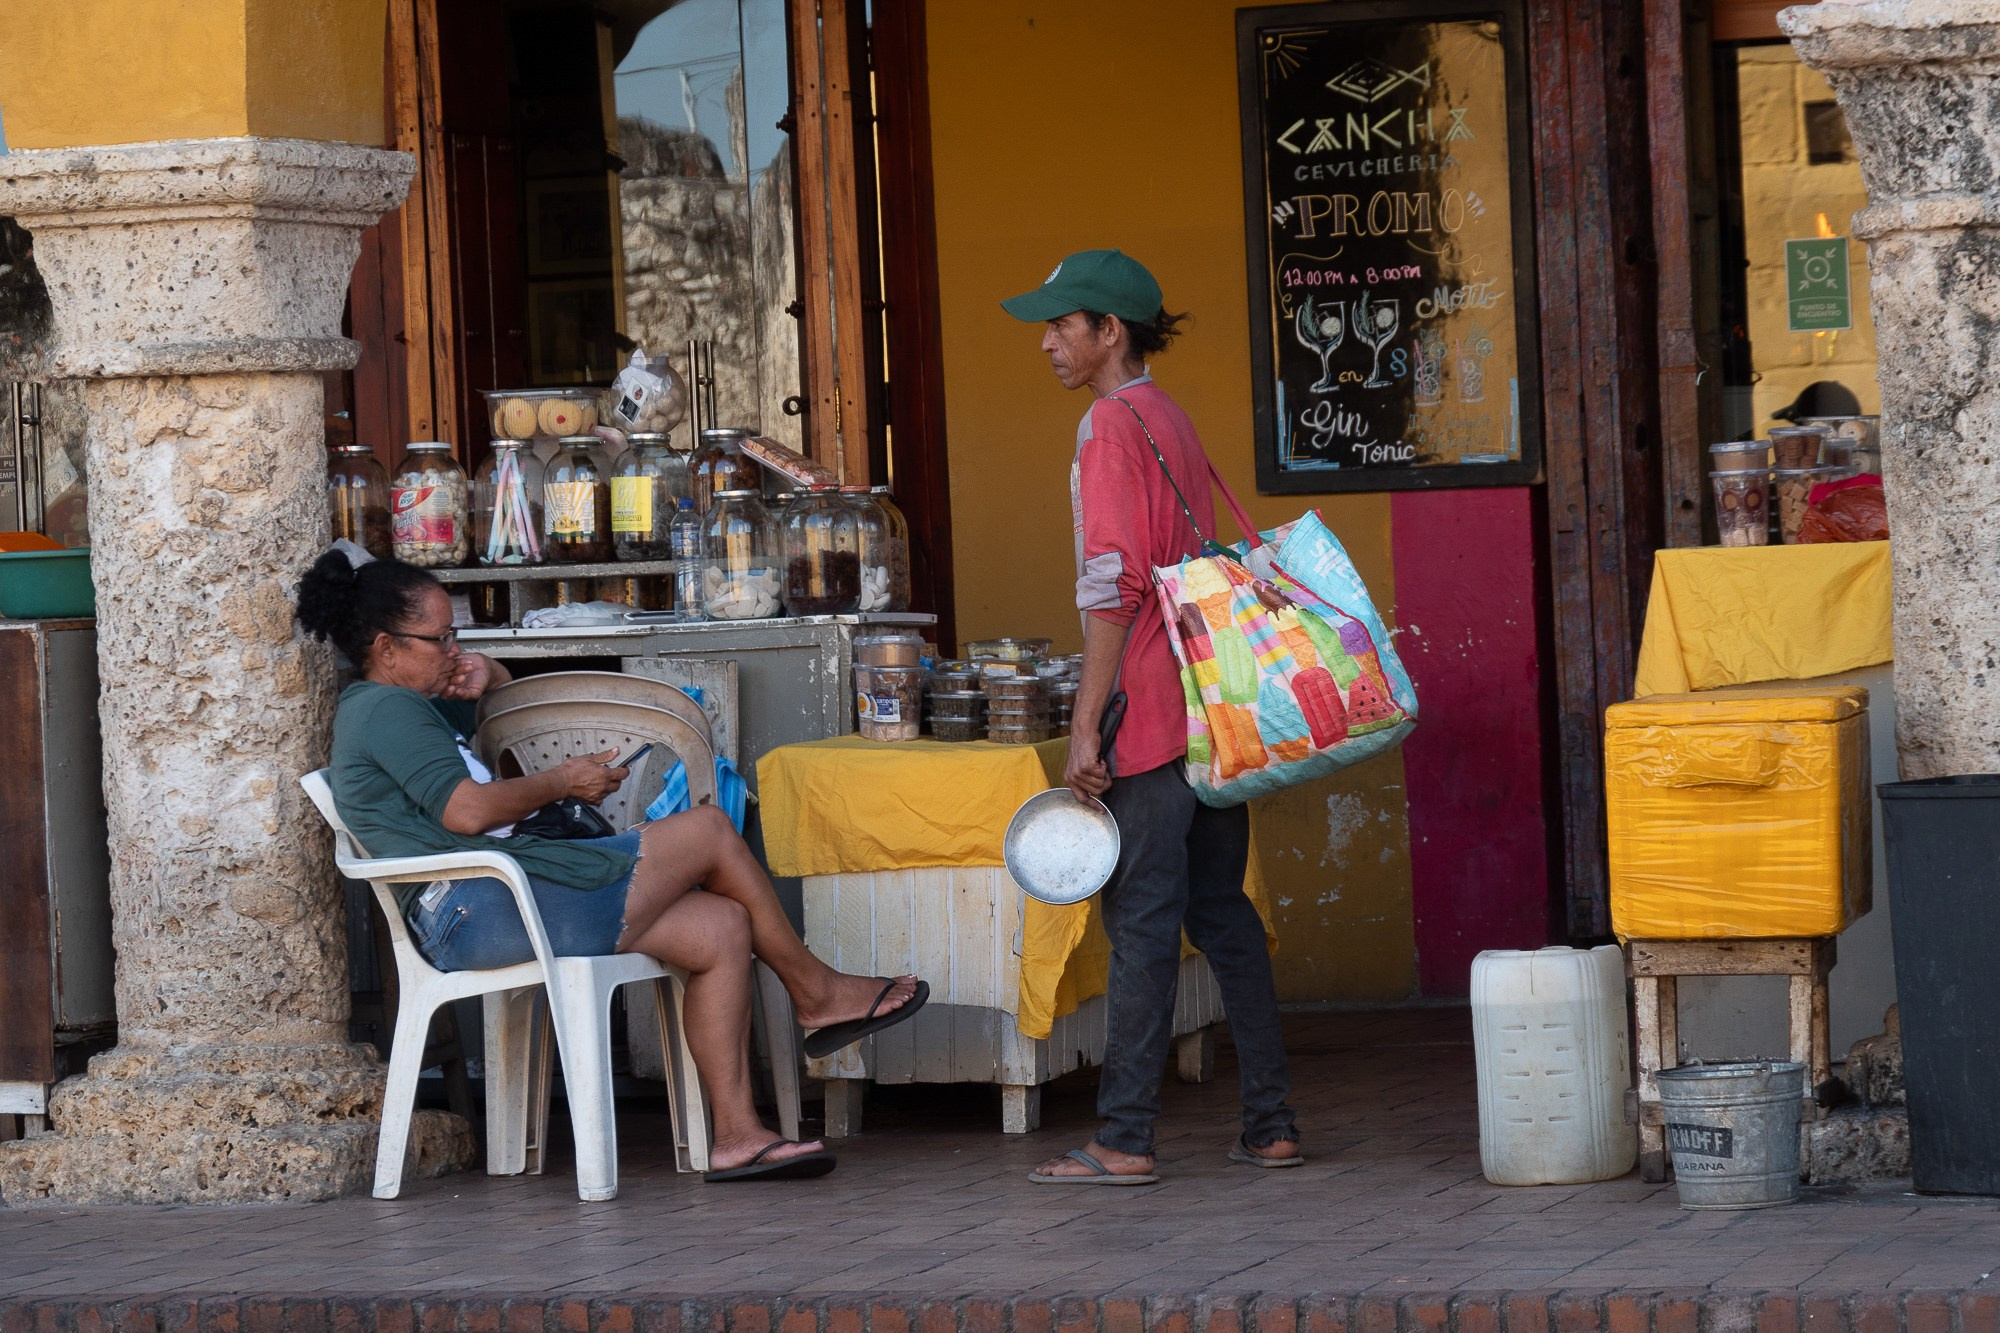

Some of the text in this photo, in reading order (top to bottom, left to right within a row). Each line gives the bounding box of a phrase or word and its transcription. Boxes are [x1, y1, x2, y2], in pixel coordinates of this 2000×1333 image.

[1277, 107, 1477, 154] CANCHA
[1294, 153, 1463, 181] CEVICHERIA
[1291, 188, 1465, 239] PROMO
[1300, 400, 1369, 450] Gin
[1351, 438, 1417, 465] Tonic
